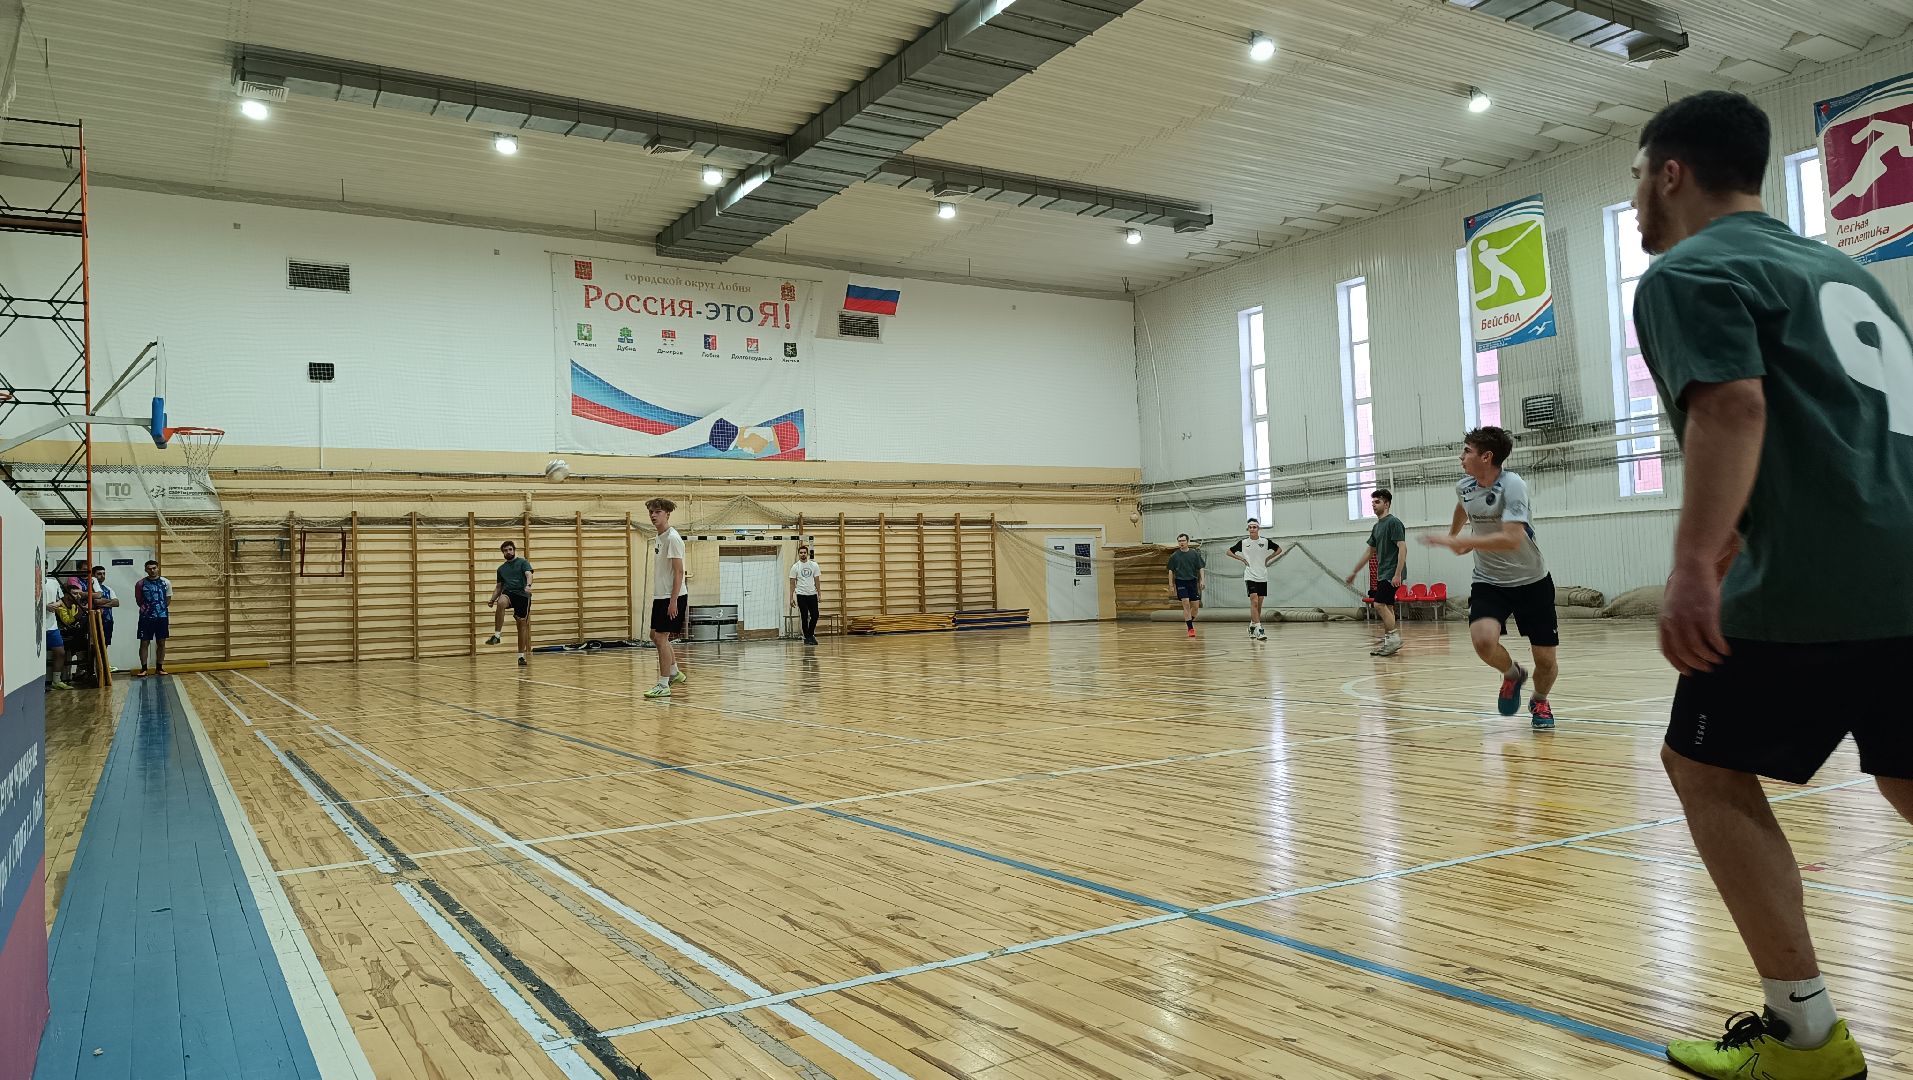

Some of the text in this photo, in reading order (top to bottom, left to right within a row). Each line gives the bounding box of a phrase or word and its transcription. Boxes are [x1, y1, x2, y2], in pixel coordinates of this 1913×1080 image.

[1837, 225, 1890, 248] атлетика
[625, 272, 751, 293] городской округ Лобня
[1480, 311, 1521, 331] Бейсбол
[616, 344, 637, 352] Дубна
[1819, 281, 1913, 437] 9
[105, 482, 132, 497] ГТО
[716, 608, 724, 619] 3
[1694, 713, 1708, 745] KIPSTA
